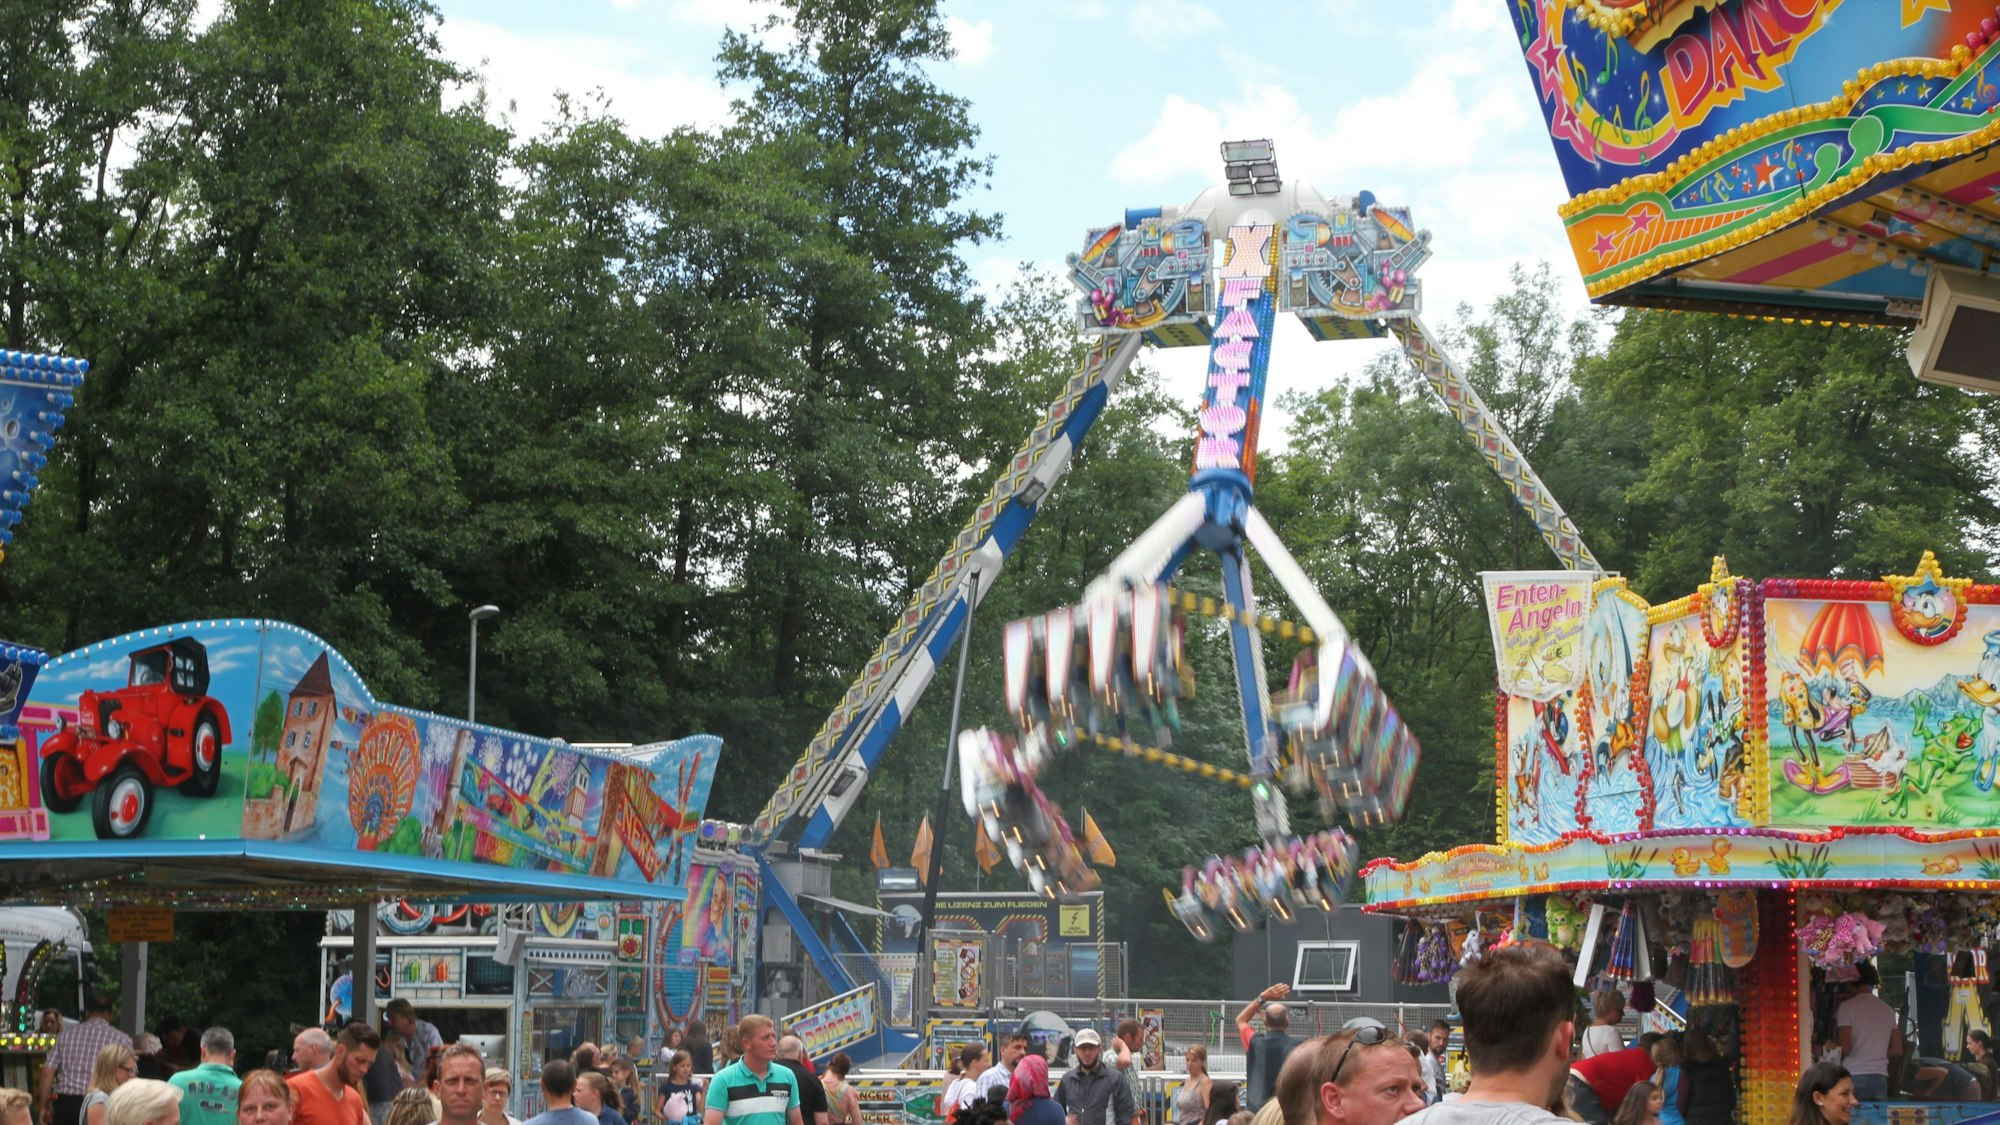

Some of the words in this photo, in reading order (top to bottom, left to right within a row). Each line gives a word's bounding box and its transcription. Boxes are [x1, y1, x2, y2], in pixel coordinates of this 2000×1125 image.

[1496, 583, 1567, 612] Enten-
[1507, 598, 1583, 635] Angeln
[948, 901, 982, 909] LIZENZ
